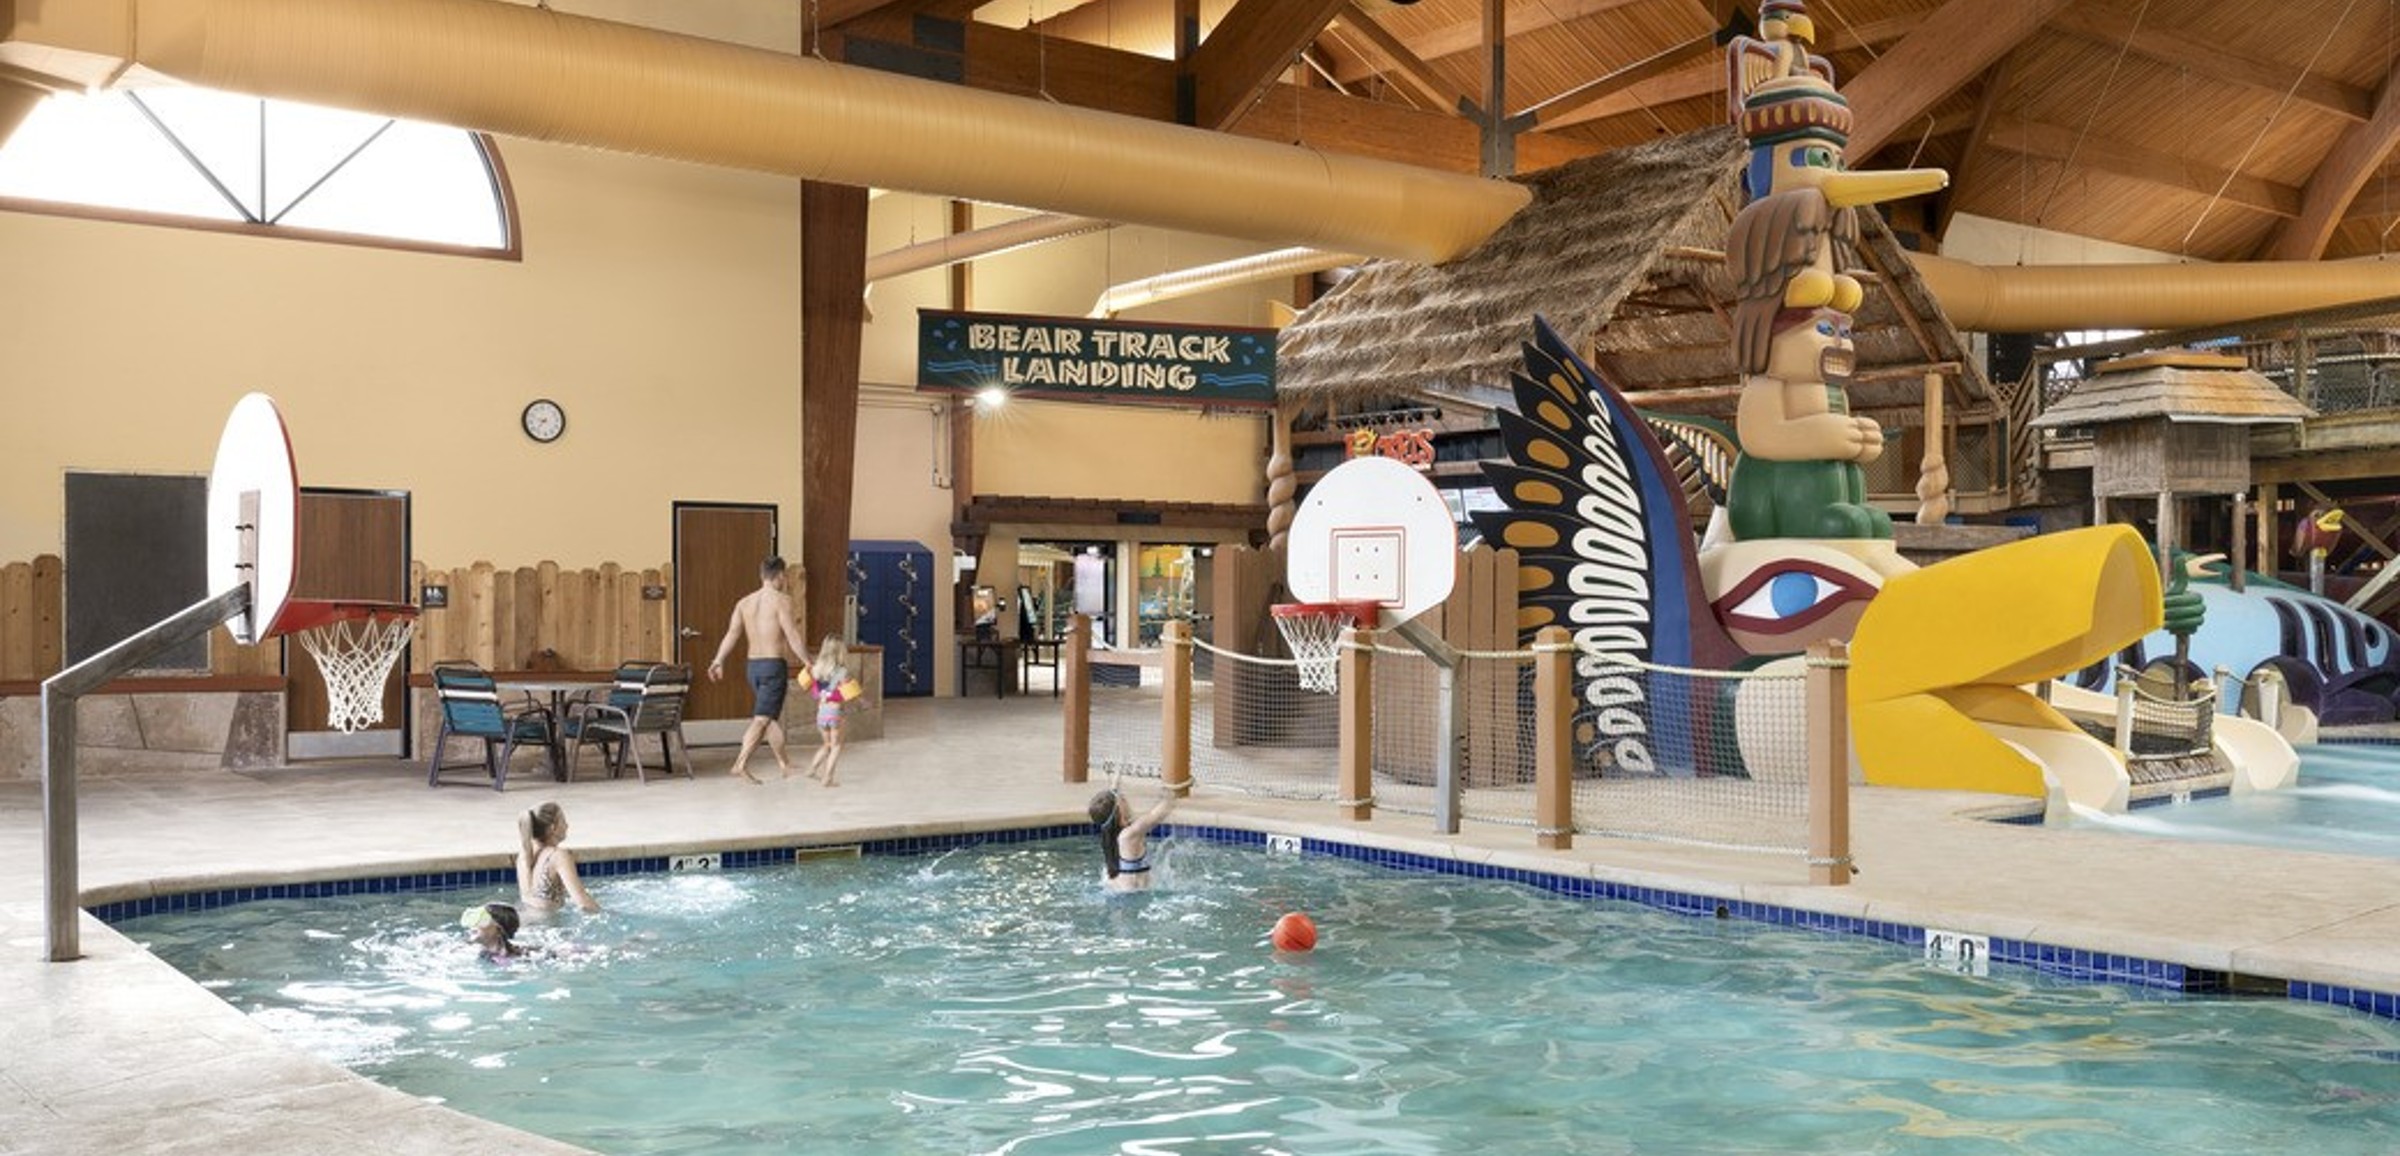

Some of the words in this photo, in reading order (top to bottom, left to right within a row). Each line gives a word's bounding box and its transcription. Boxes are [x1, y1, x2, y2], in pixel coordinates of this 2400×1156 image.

[968, 323, 1082, 355] BEAR
[1091, 329, 1232, 363] TRACK
[1002, 355, 1197, 391] LANDING
